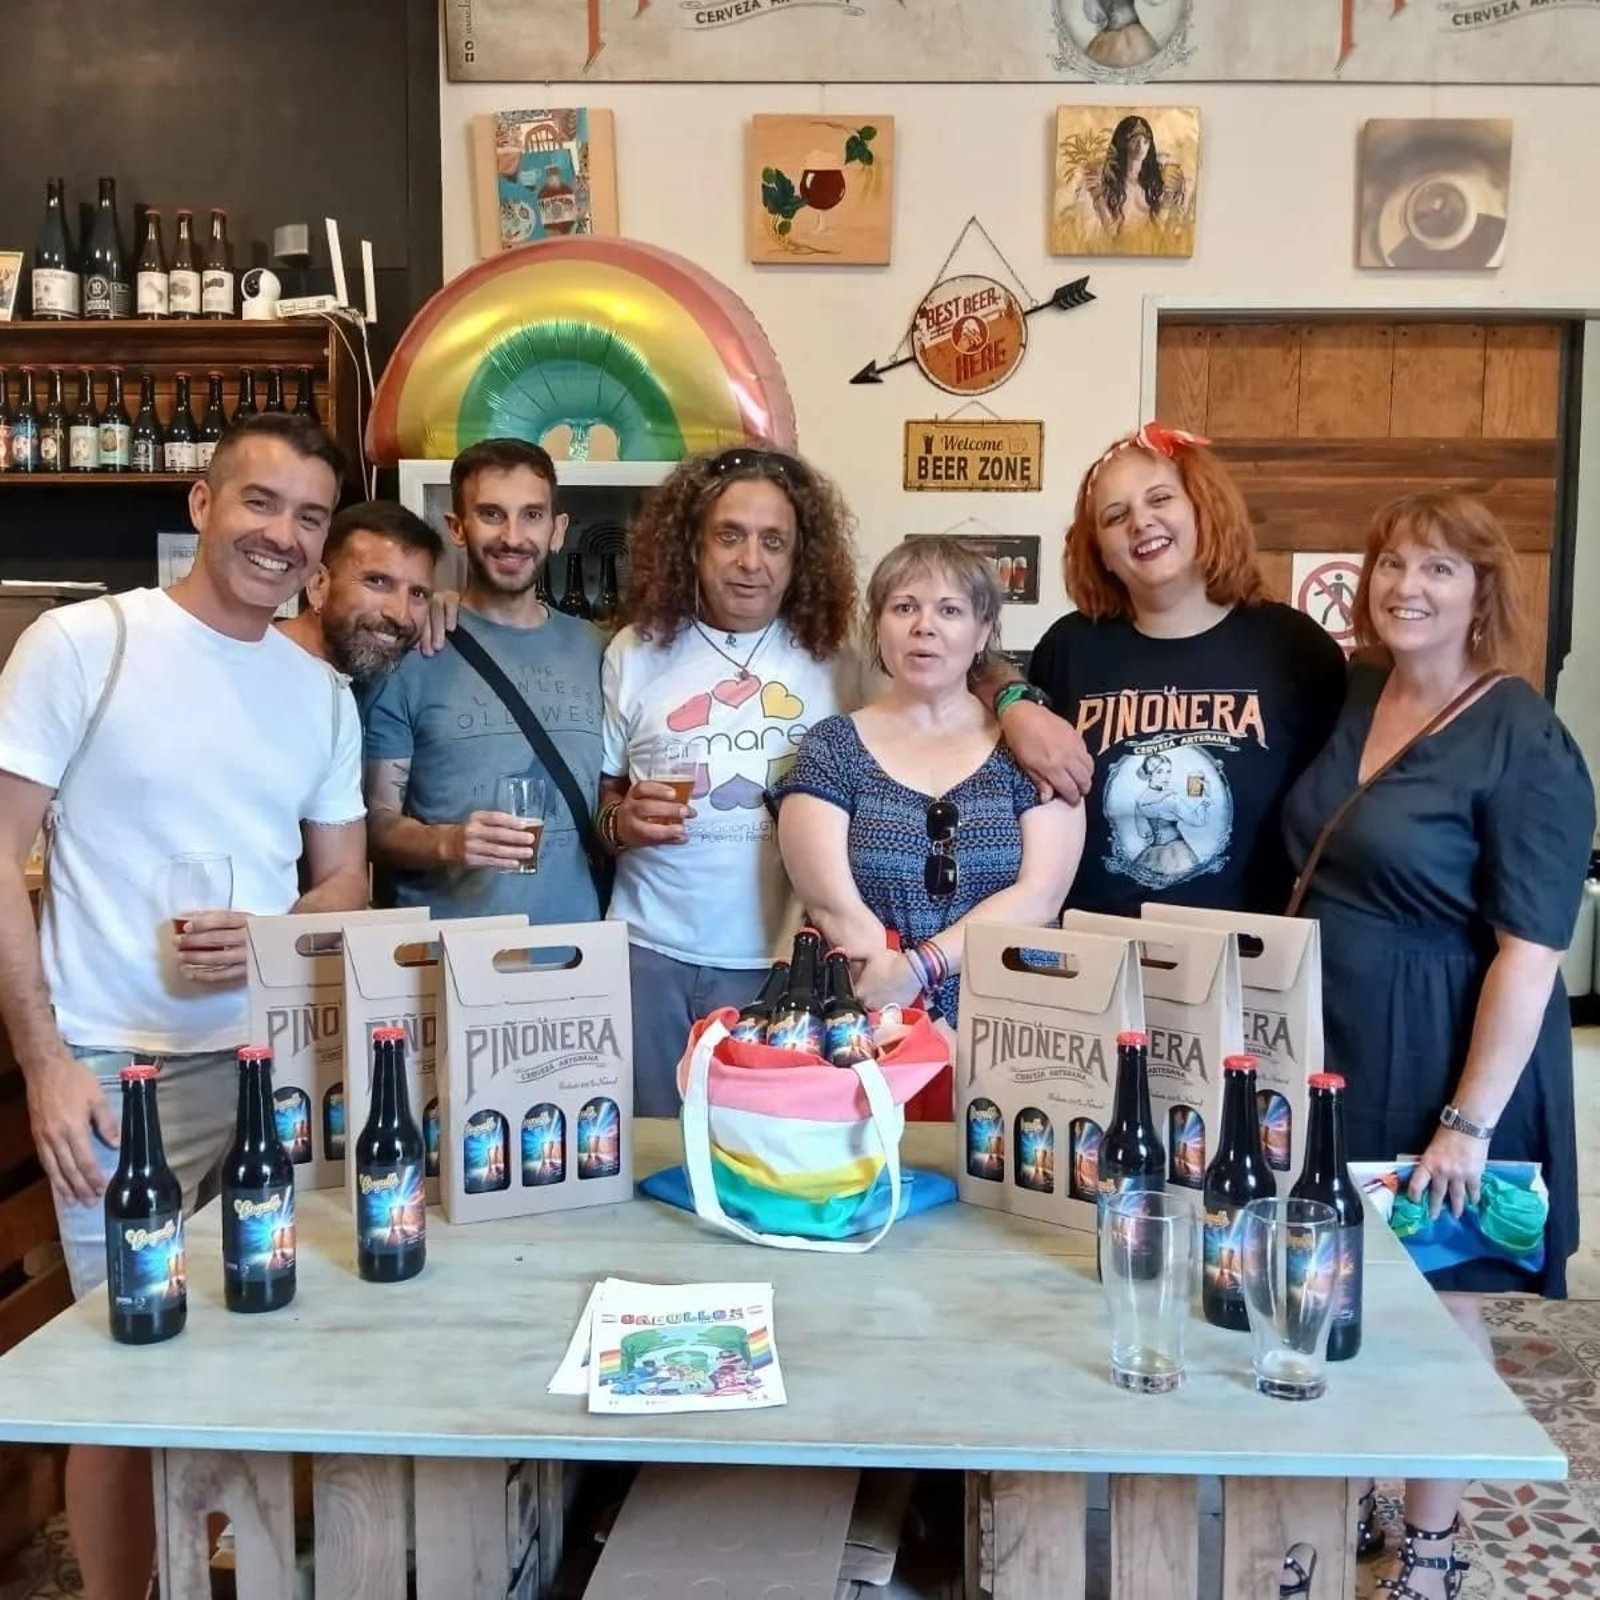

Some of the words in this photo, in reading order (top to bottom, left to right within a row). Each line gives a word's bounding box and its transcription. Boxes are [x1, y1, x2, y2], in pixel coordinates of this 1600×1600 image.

[695, 0, 761, 24] CERVEZA
[1452, 0, 1520, 25] CERVEZA
[926, 296, 962, 329] BEST
[963, 287, 998, 315] BEER
[955, 339, 1006, 384] HERE
[941, 434, 1003, 452] Welcome
[917, 456, 968, 480] BEER
[978, 456, 1031, 481] ZONE
[1163, 685, 1178, 696] LA
[1075, 688, 1270, 756] PIÑONERA
[463, 1017, 623, 1105] PIÑONERA
[968, 1017, 1110, 1088] PIÑONERA
